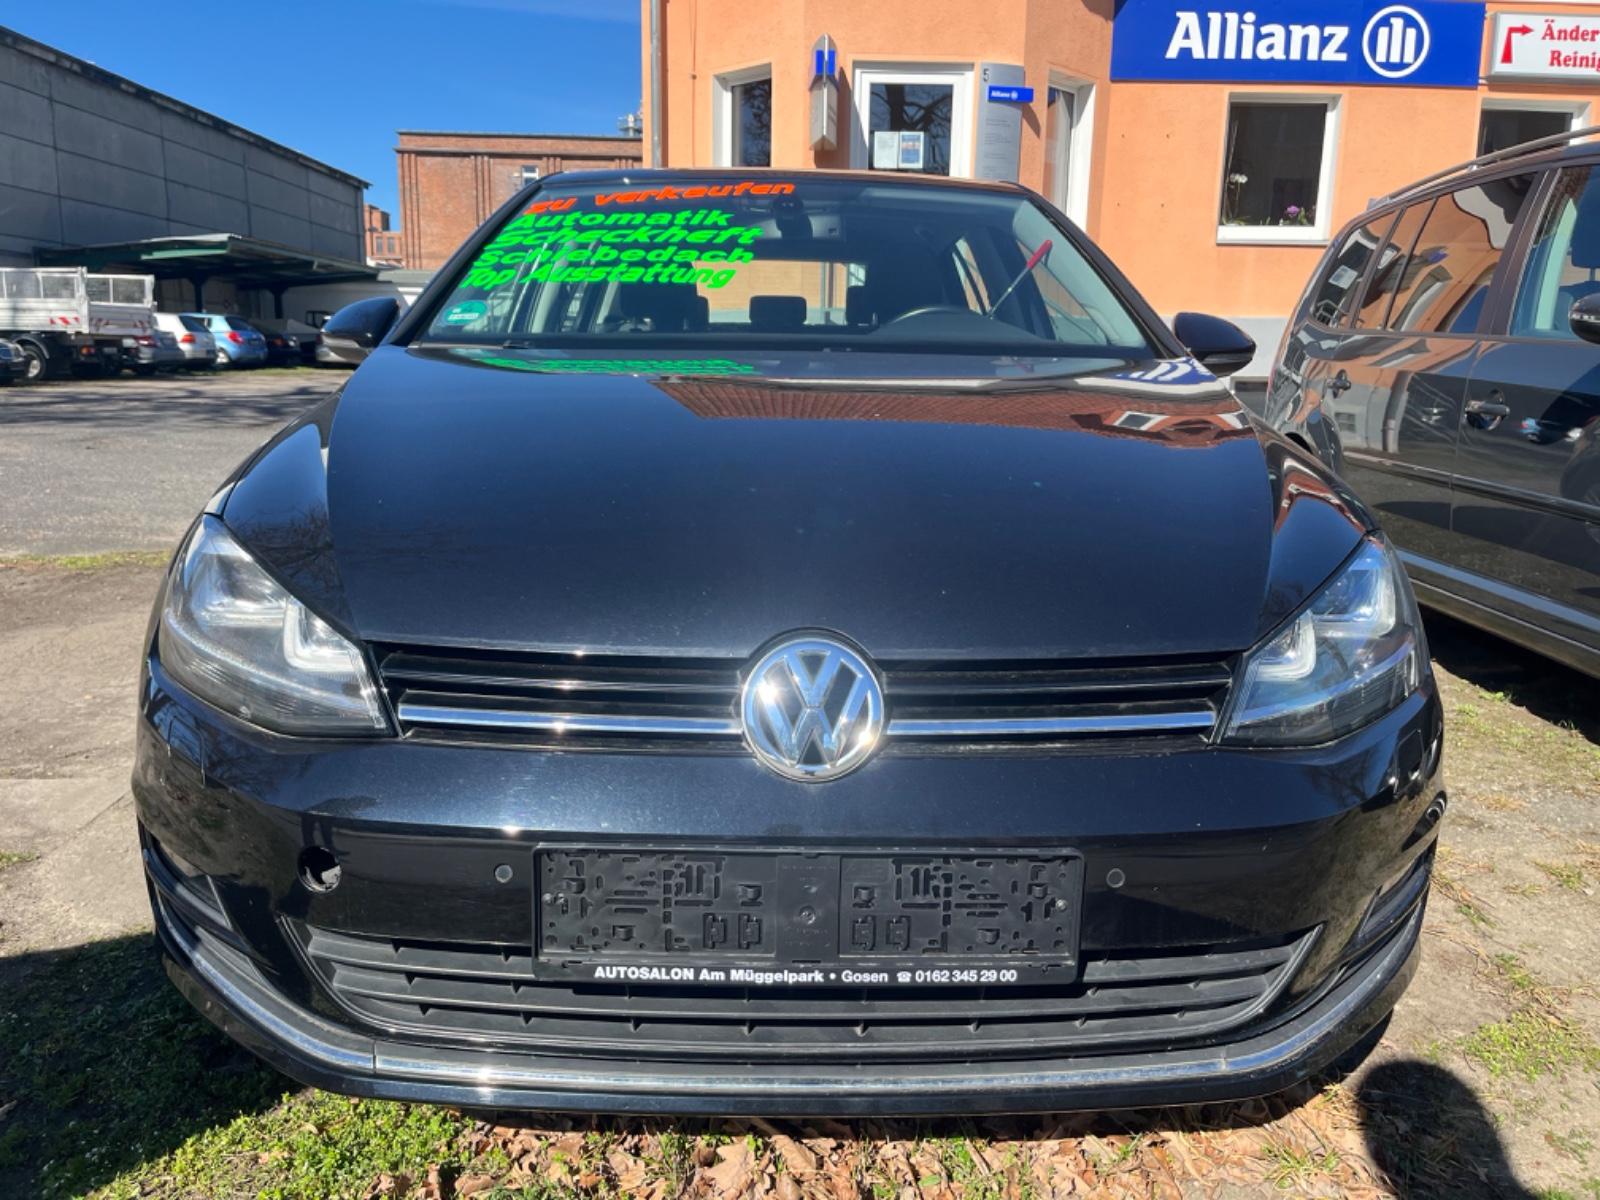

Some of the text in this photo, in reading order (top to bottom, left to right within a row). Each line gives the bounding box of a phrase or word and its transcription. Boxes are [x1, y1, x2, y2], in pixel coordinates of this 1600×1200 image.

[1165, 11, 1349, 62] Allianz
[983, 68, 991, 82] 5
[523, 182, 795, 214] zu verkaufen
[503, 210, 734, 230] Automatik
[483, 225, 764, 250] Scheckheft
[473, 245, 754, 267] Schiebedach
[460, 263, 736, 291] Top Ausstattung
[594, 966, 1017, 984] AUTOSALON Am Müggelpark Gosen 0162 345 29 00
